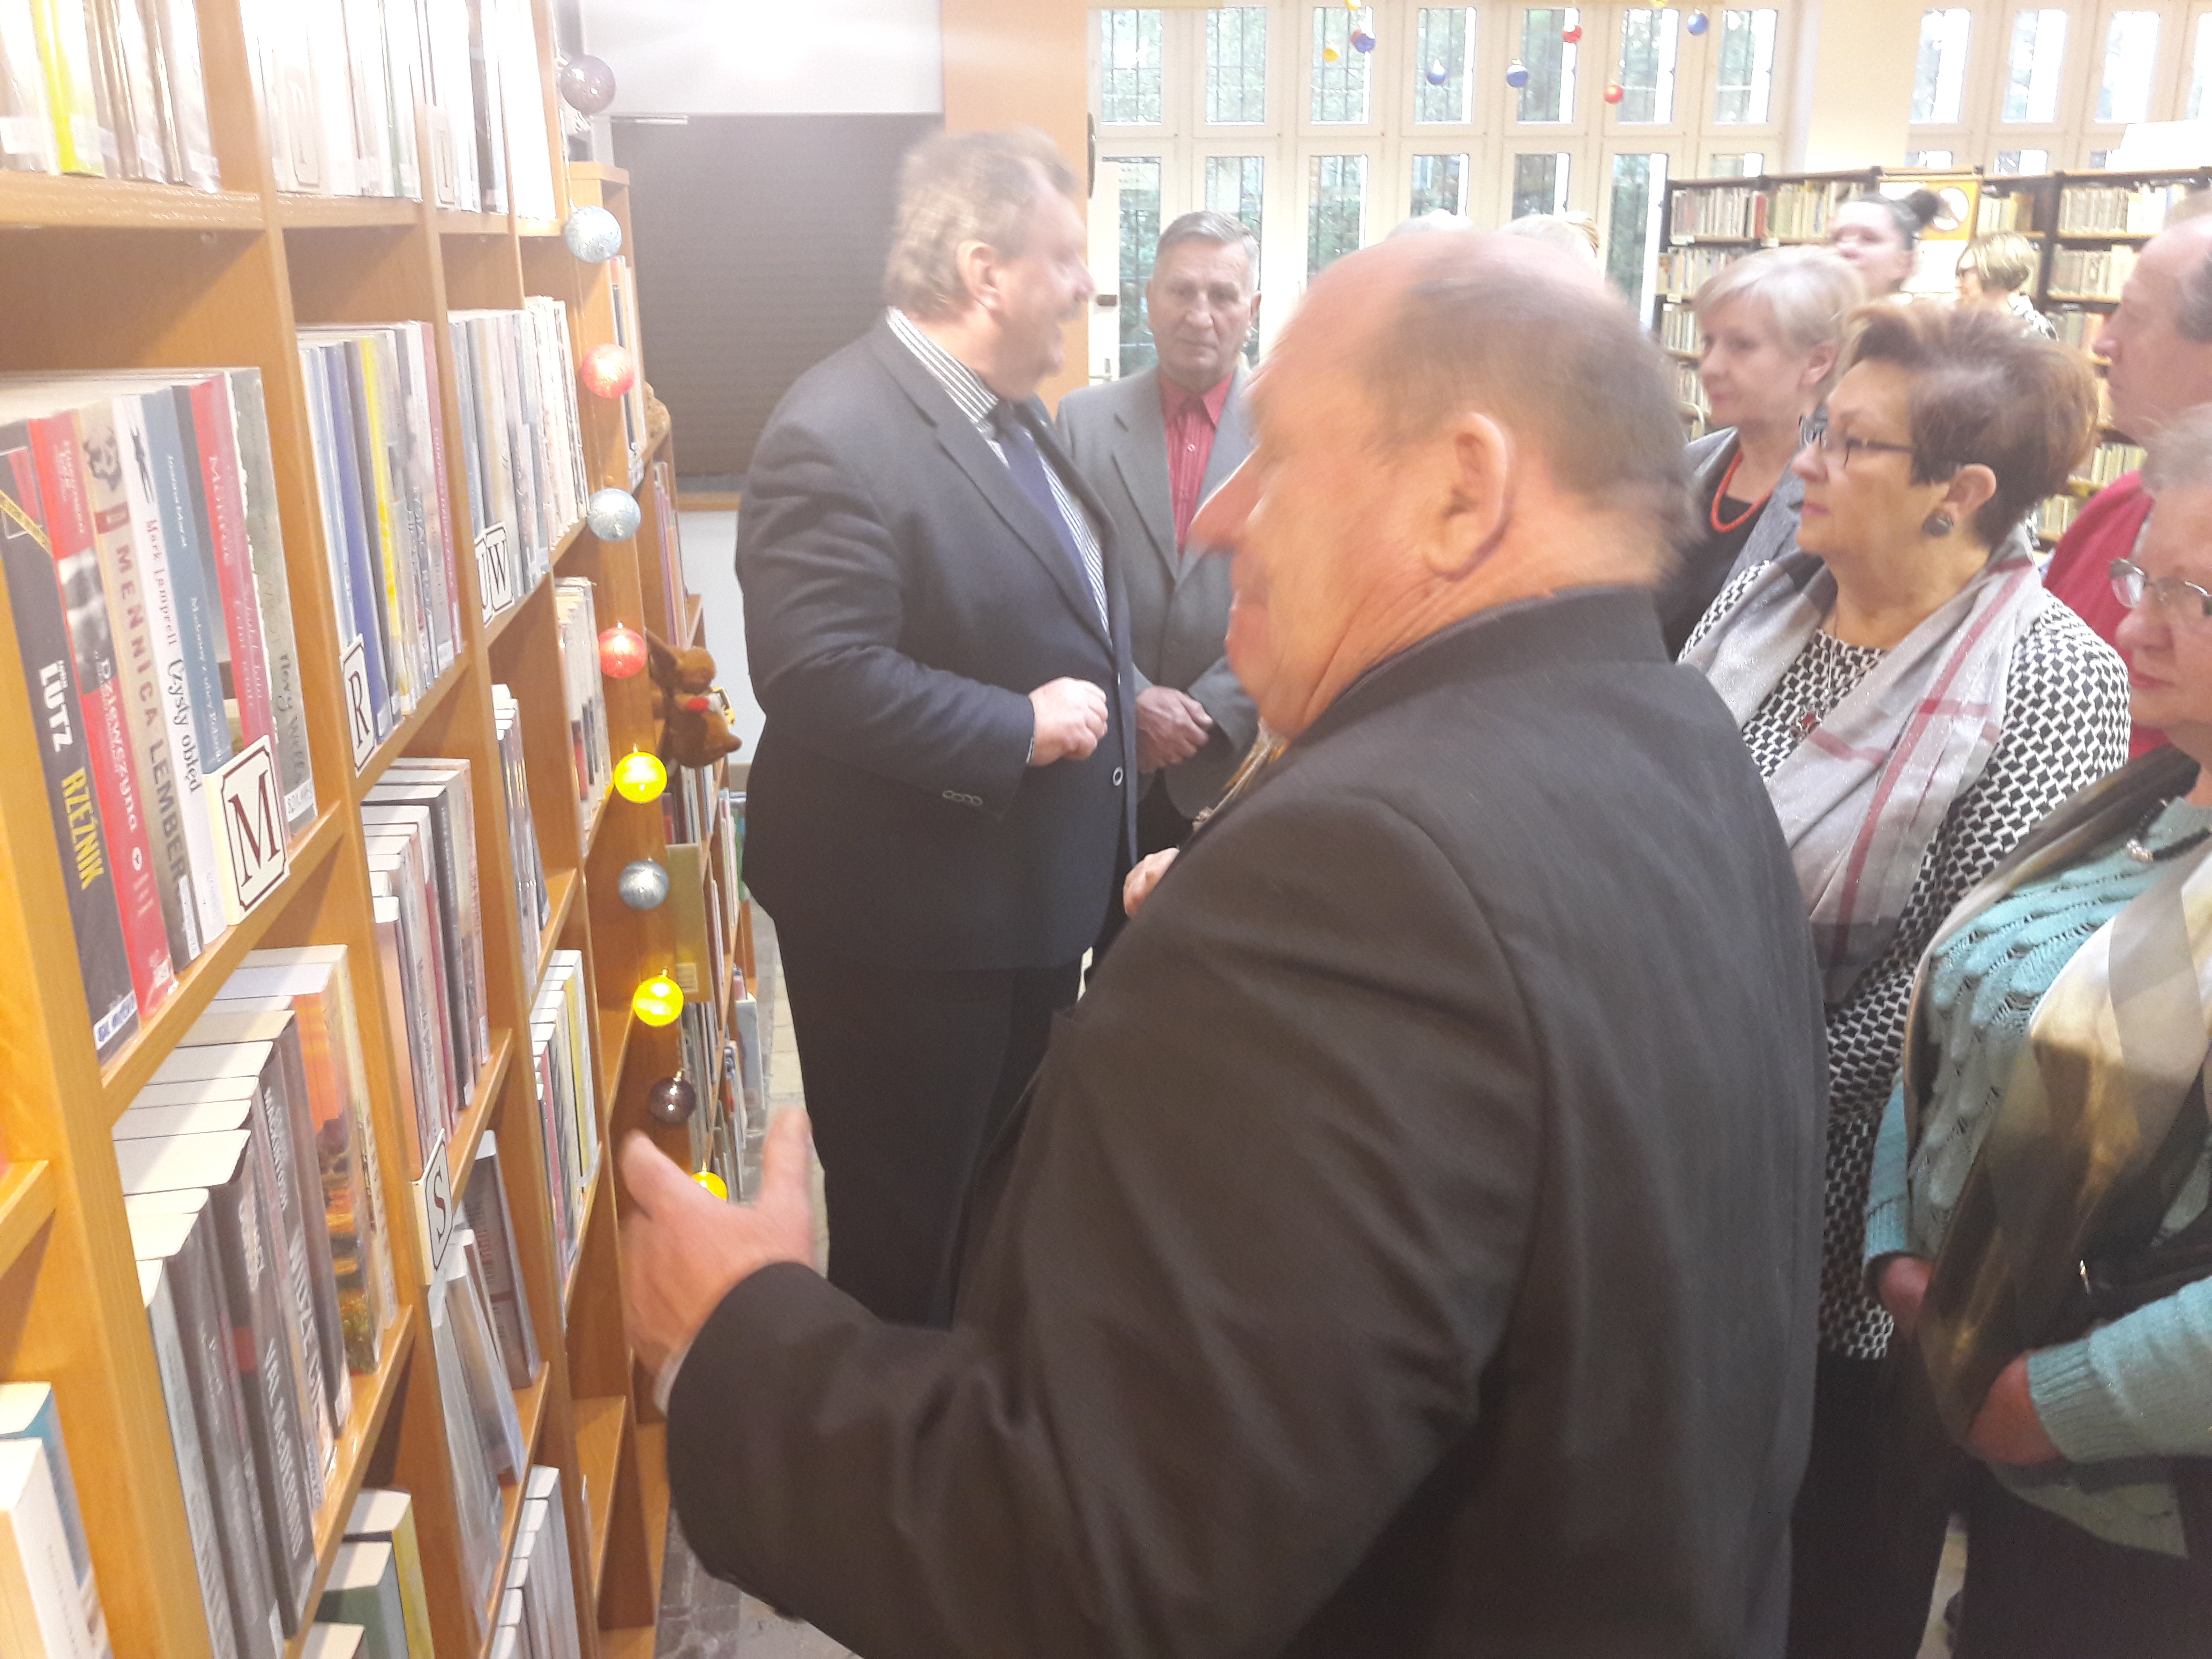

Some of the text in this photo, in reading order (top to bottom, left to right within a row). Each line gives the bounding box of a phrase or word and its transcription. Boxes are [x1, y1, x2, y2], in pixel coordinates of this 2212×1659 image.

[146, 519, 162, 562] Mark
[488, 541, 506, 594] W
[39, 663, 73, 752] LUTZ
[116, 545, 189, 888] MENNICA LEMBER
[166, 659, 201, 795] Czysty obłęd
[348, 671, 371, 750] R
[61, 766, 104, 891] RZEŹNIK
[228, 769, 281, 887] M
[434, 1172, 446, 1245] S
